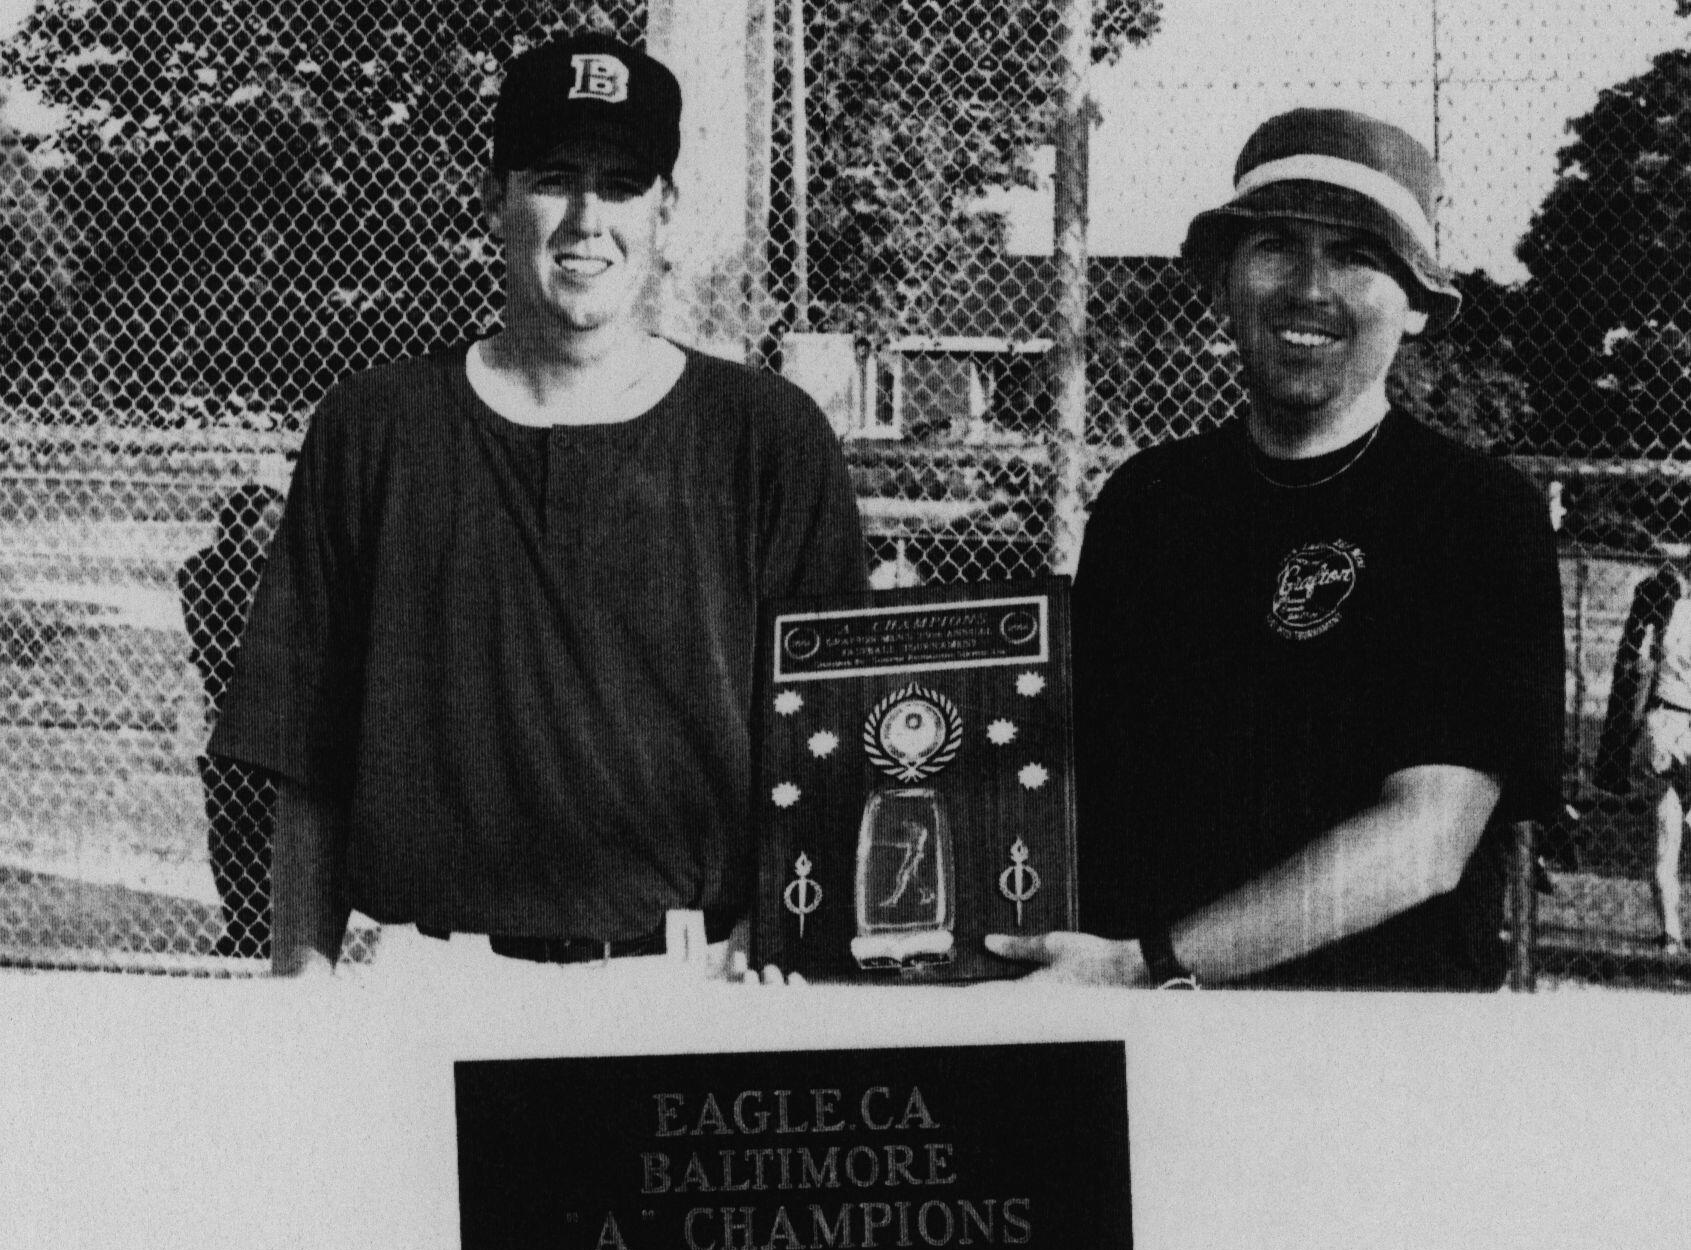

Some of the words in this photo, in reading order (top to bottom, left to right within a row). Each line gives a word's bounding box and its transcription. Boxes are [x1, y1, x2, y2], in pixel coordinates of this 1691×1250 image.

[568, 54, 629, 103] B
[872, 613, 987, 632] CHAMPIONS
[653, 1086, 940, 1138] EAGLE.CA
[640, 1143, 957, 1194] BALTIMORE
